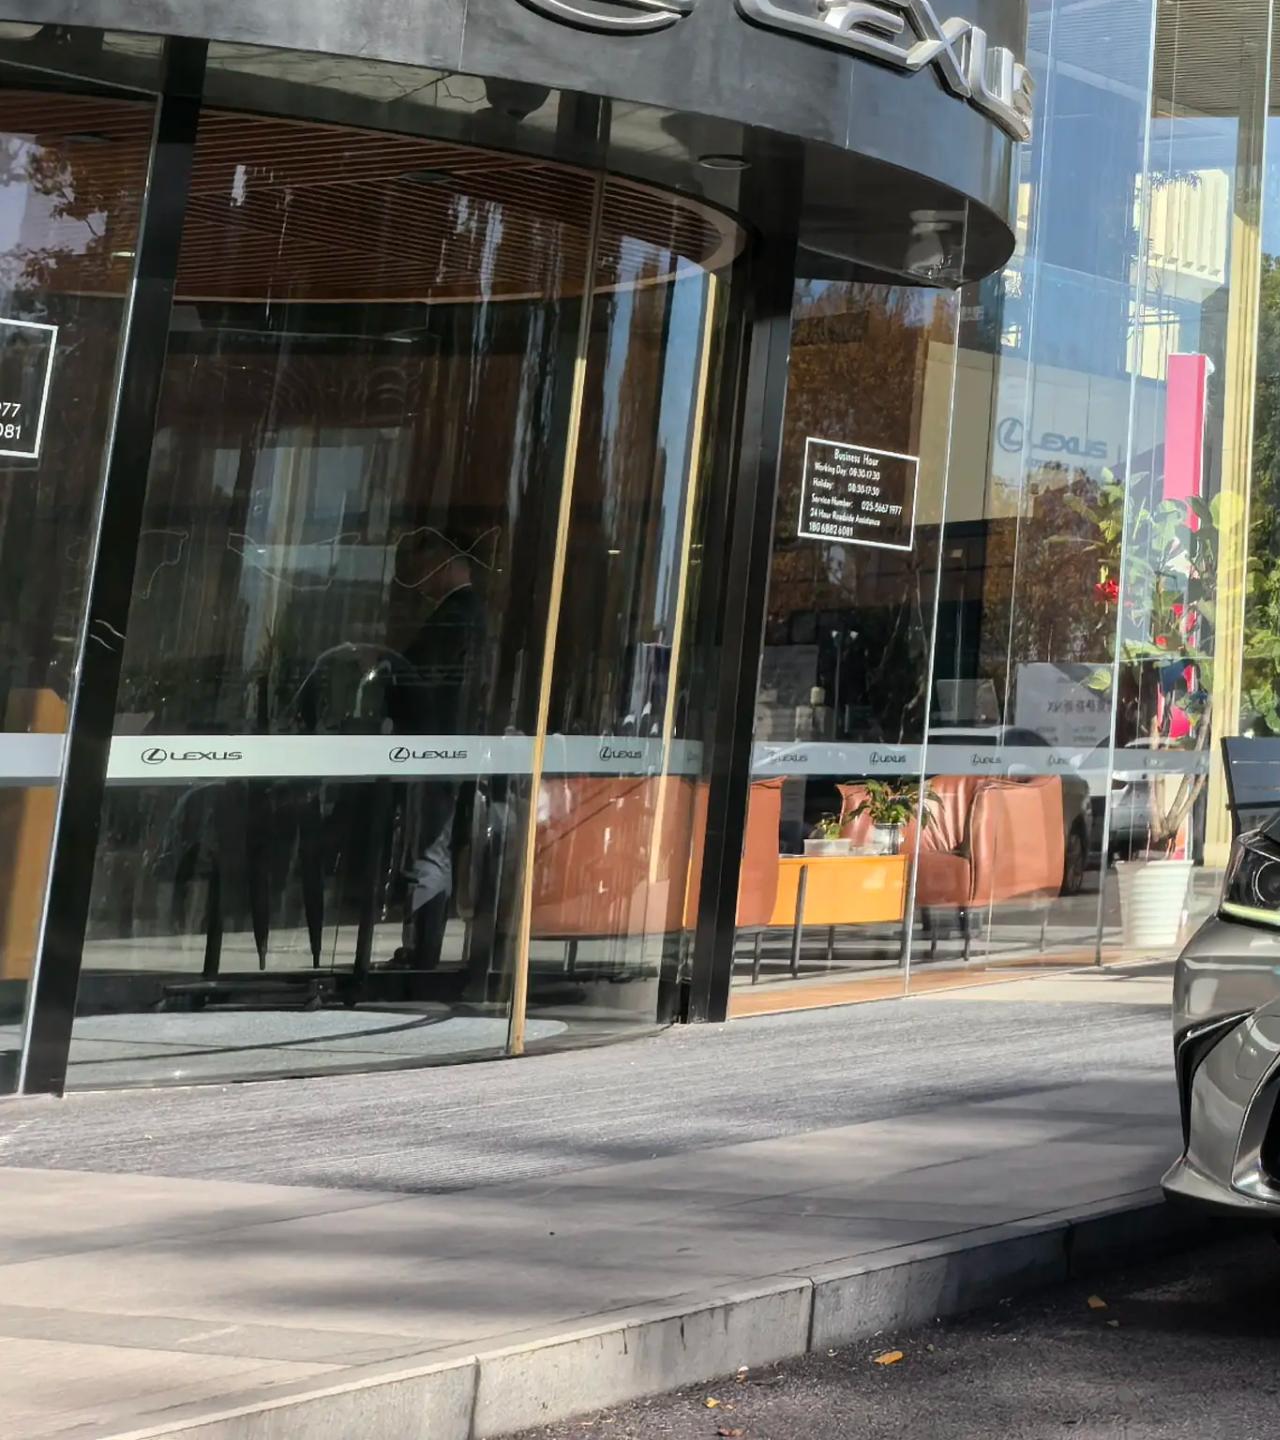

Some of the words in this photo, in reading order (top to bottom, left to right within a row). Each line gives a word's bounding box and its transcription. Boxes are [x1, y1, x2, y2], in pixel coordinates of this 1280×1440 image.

[834, 448, 861, 464] Business
[863, 454, 879, 466] Hour
[814, 462, 836, 475] Working
[811, 493, 831, 504] Service
[810, 508, 817, 517] 24
[818, 509, 831, 519] Hour
[832, 511, 855, 522] Roadside
[170, 751, 243, 761] LEXUS
[412, 749, 468, 759] LEXUS
[612, 750, 642, 759] LEXUS
